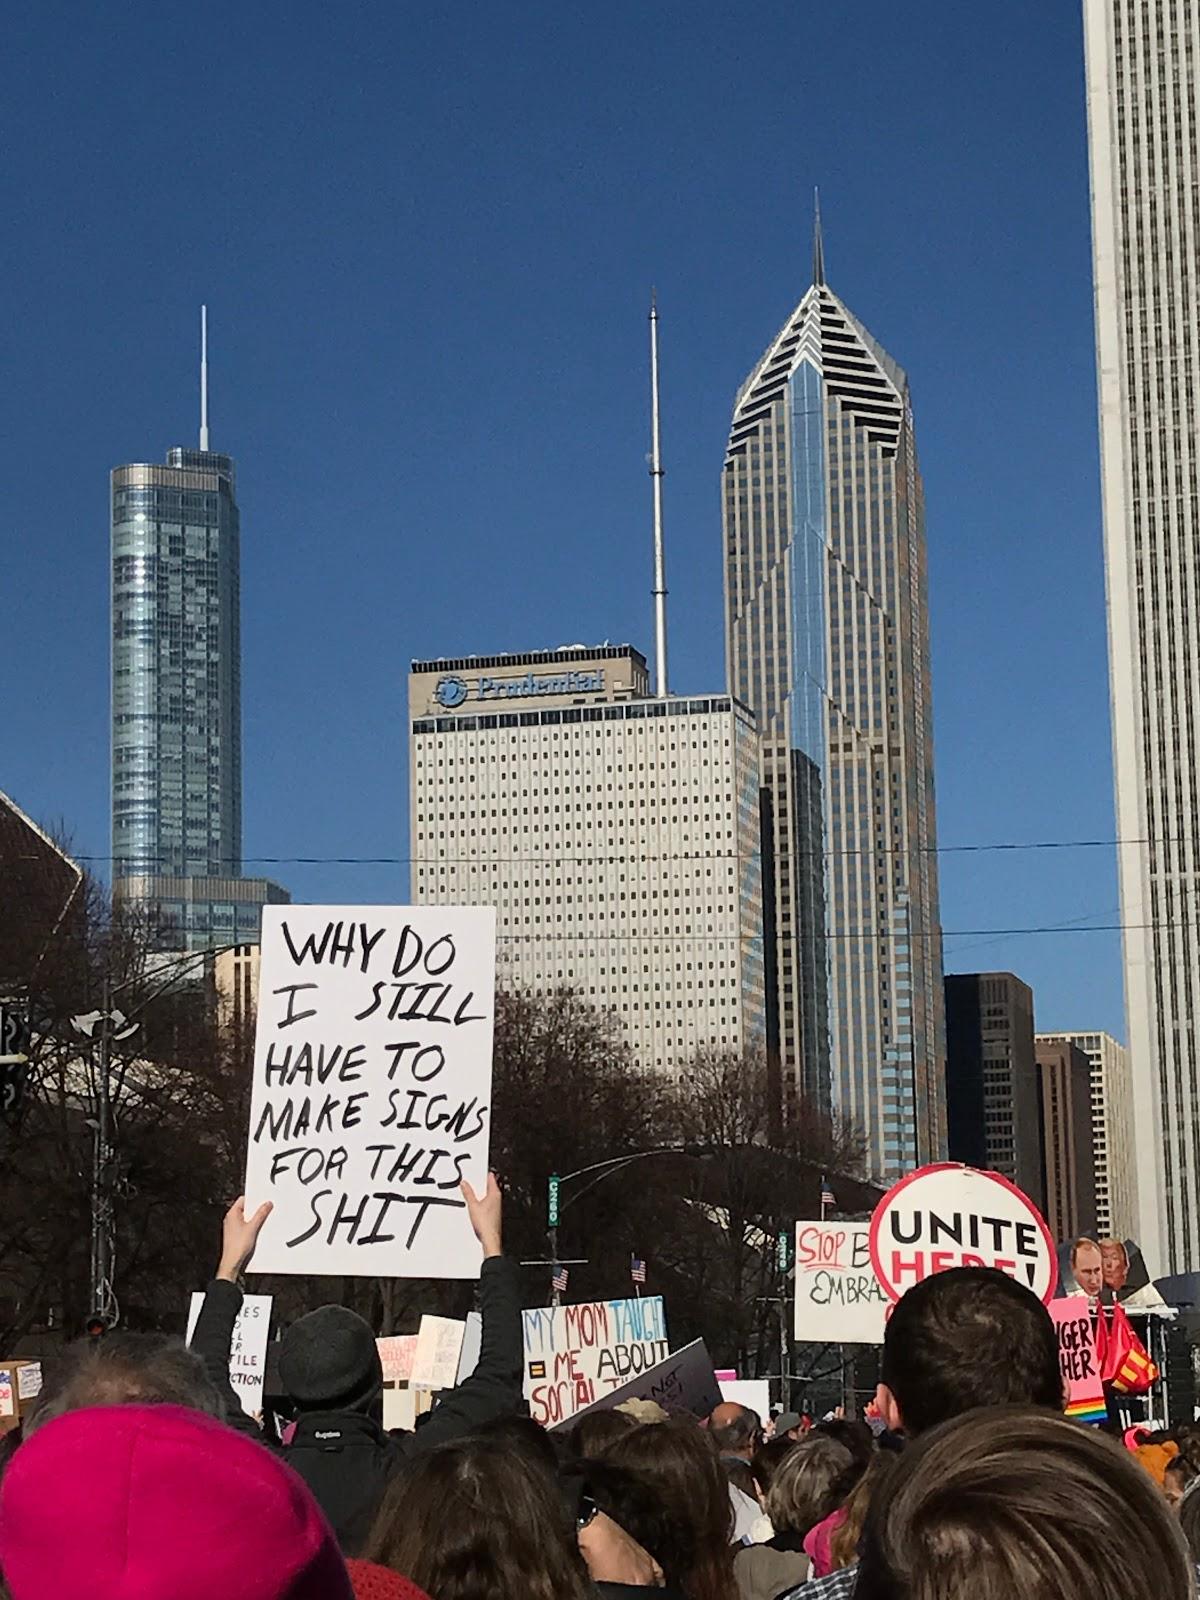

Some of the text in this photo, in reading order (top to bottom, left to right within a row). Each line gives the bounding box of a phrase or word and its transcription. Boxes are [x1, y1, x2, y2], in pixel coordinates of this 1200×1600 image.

[281, 921, 456, 978] WHY DO
[272, 981, 487, 1029] I STILL
[265, 1041, 446, 1087] HAVE TO
[253, 1088, 488, 1143] MAKE SIGNS
[269, 1142, 472, 1190] FOR THIS
[286, 1189, 466, 1250] SHIT
[891, 1210, 1038, 1258] UNITE
[798, 1227, 846, 1266] STOP
[239, 1306, 260, 1318] ES
[524, 1305, 557, 1352] MY
[564, 1302, 609, 1350] MOM
[554, 1350, 585, 1382] ME
[597, 1340, 669, 1379] ABOUT
